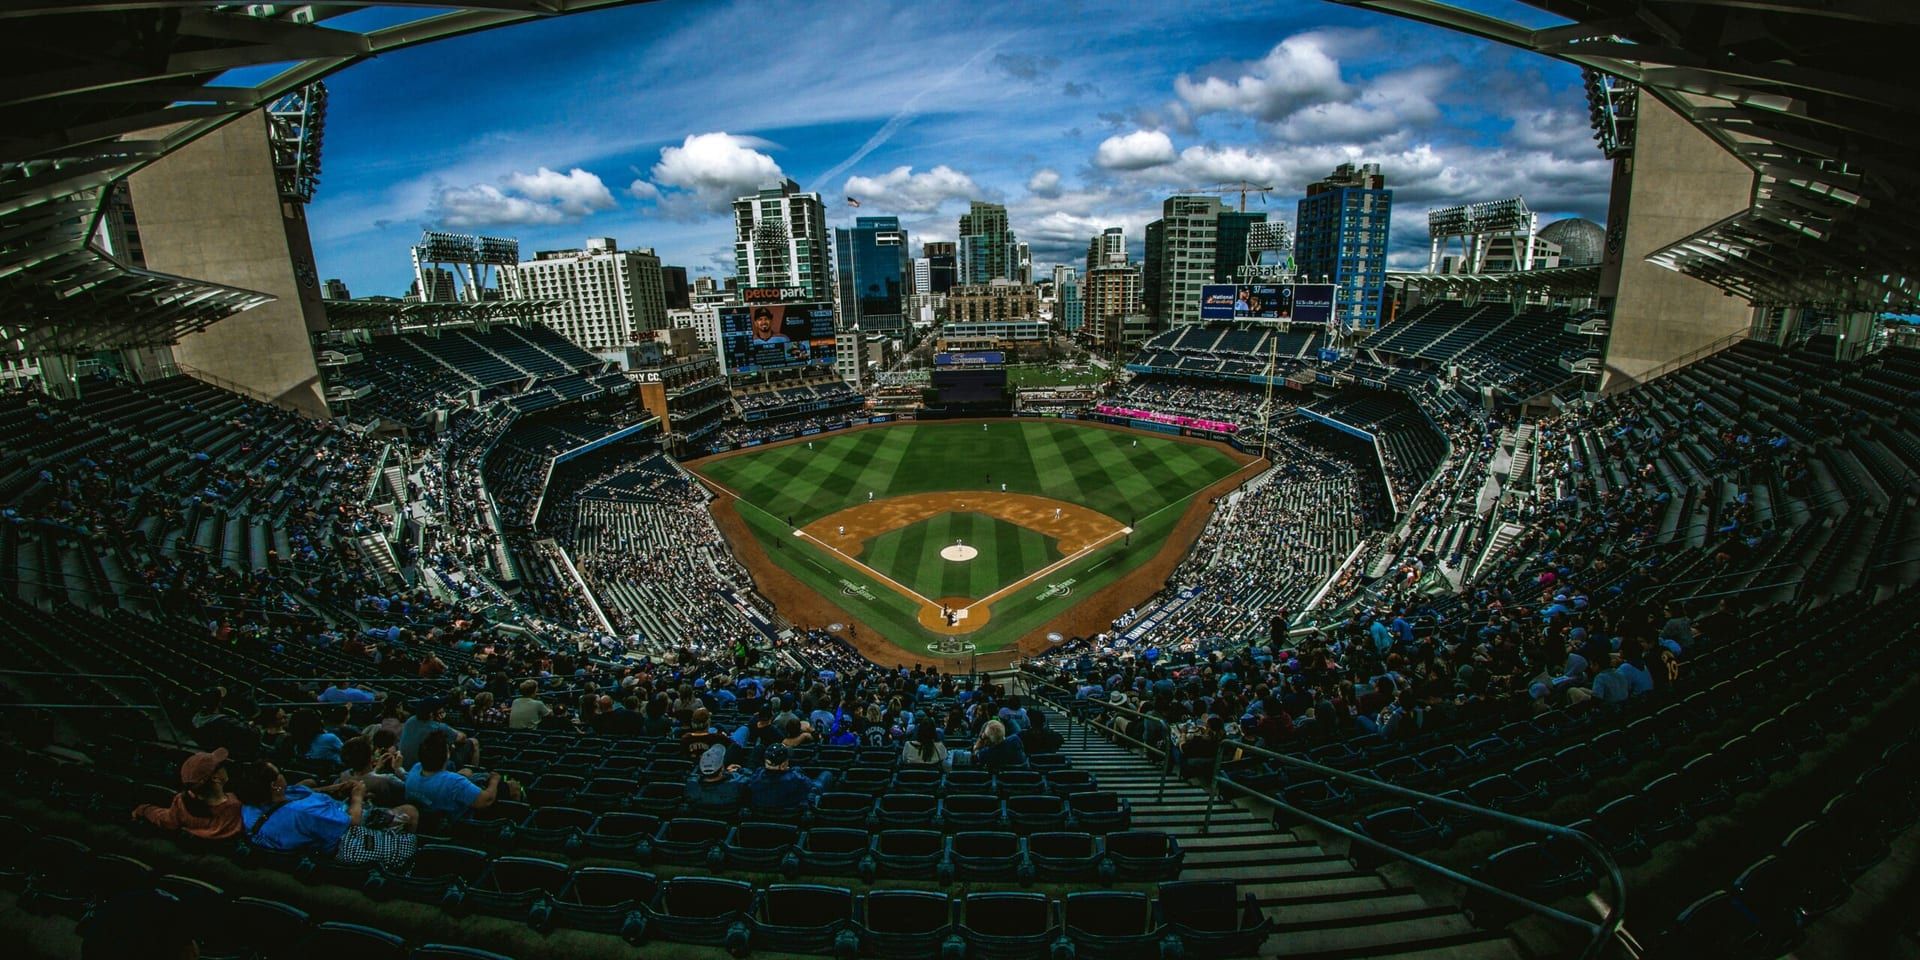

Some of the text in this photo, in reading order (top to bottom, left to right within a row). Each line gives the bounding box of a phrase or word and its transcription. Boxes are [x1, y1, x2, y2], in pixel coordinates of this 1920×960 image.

[1238, 265, 1277, 276] Viasat
[744, 288, 806, 300] petco park
[648, 372, 662, 382] CO.
[1666, 660, 1679, 680] 19
[869, 734, 883, 747] 13
